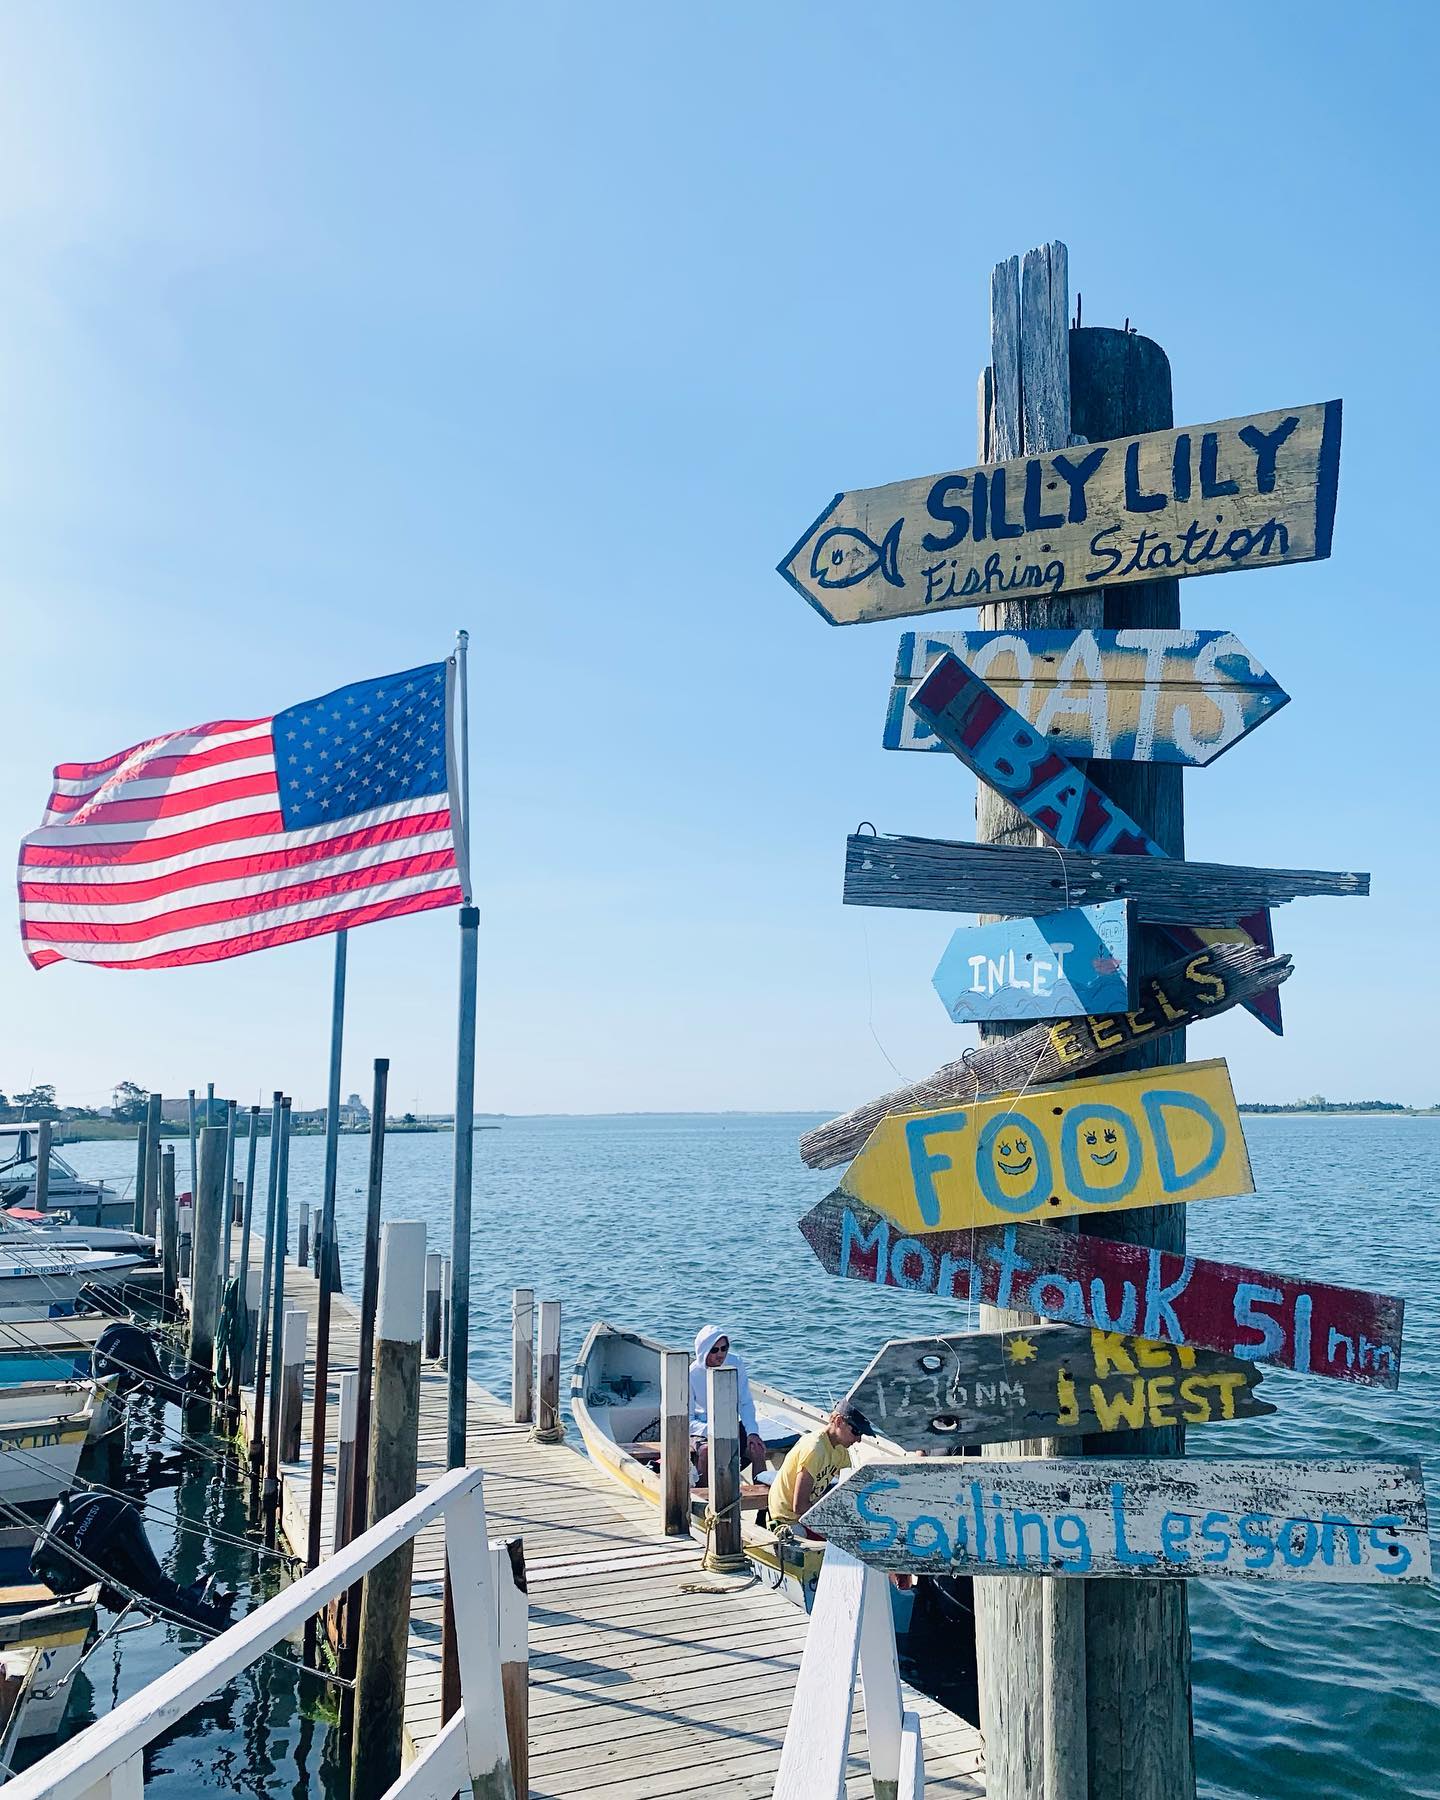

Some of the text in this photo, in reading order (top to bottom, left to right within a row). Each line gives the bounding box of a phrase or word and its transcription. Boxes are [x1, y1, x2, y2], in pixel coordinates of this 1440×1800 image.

[921, 416, 1300, 553] SILLY LILY
[920, 515, 1290, 605] Fishing Station
[900, 630, 1266, 767] BOATS
[968, 942, 1074, 997] INLET
[905, 1089, 1226, 1227] FOOD
[840, 1205, 1399, 1373] Montauk 51 nm
[1090, 1372, 1248, 1432] WEST
[76, 1504, 100, 1536] TOHATSU
[855, 1479, 1412, 1574] Sailing Lessons
